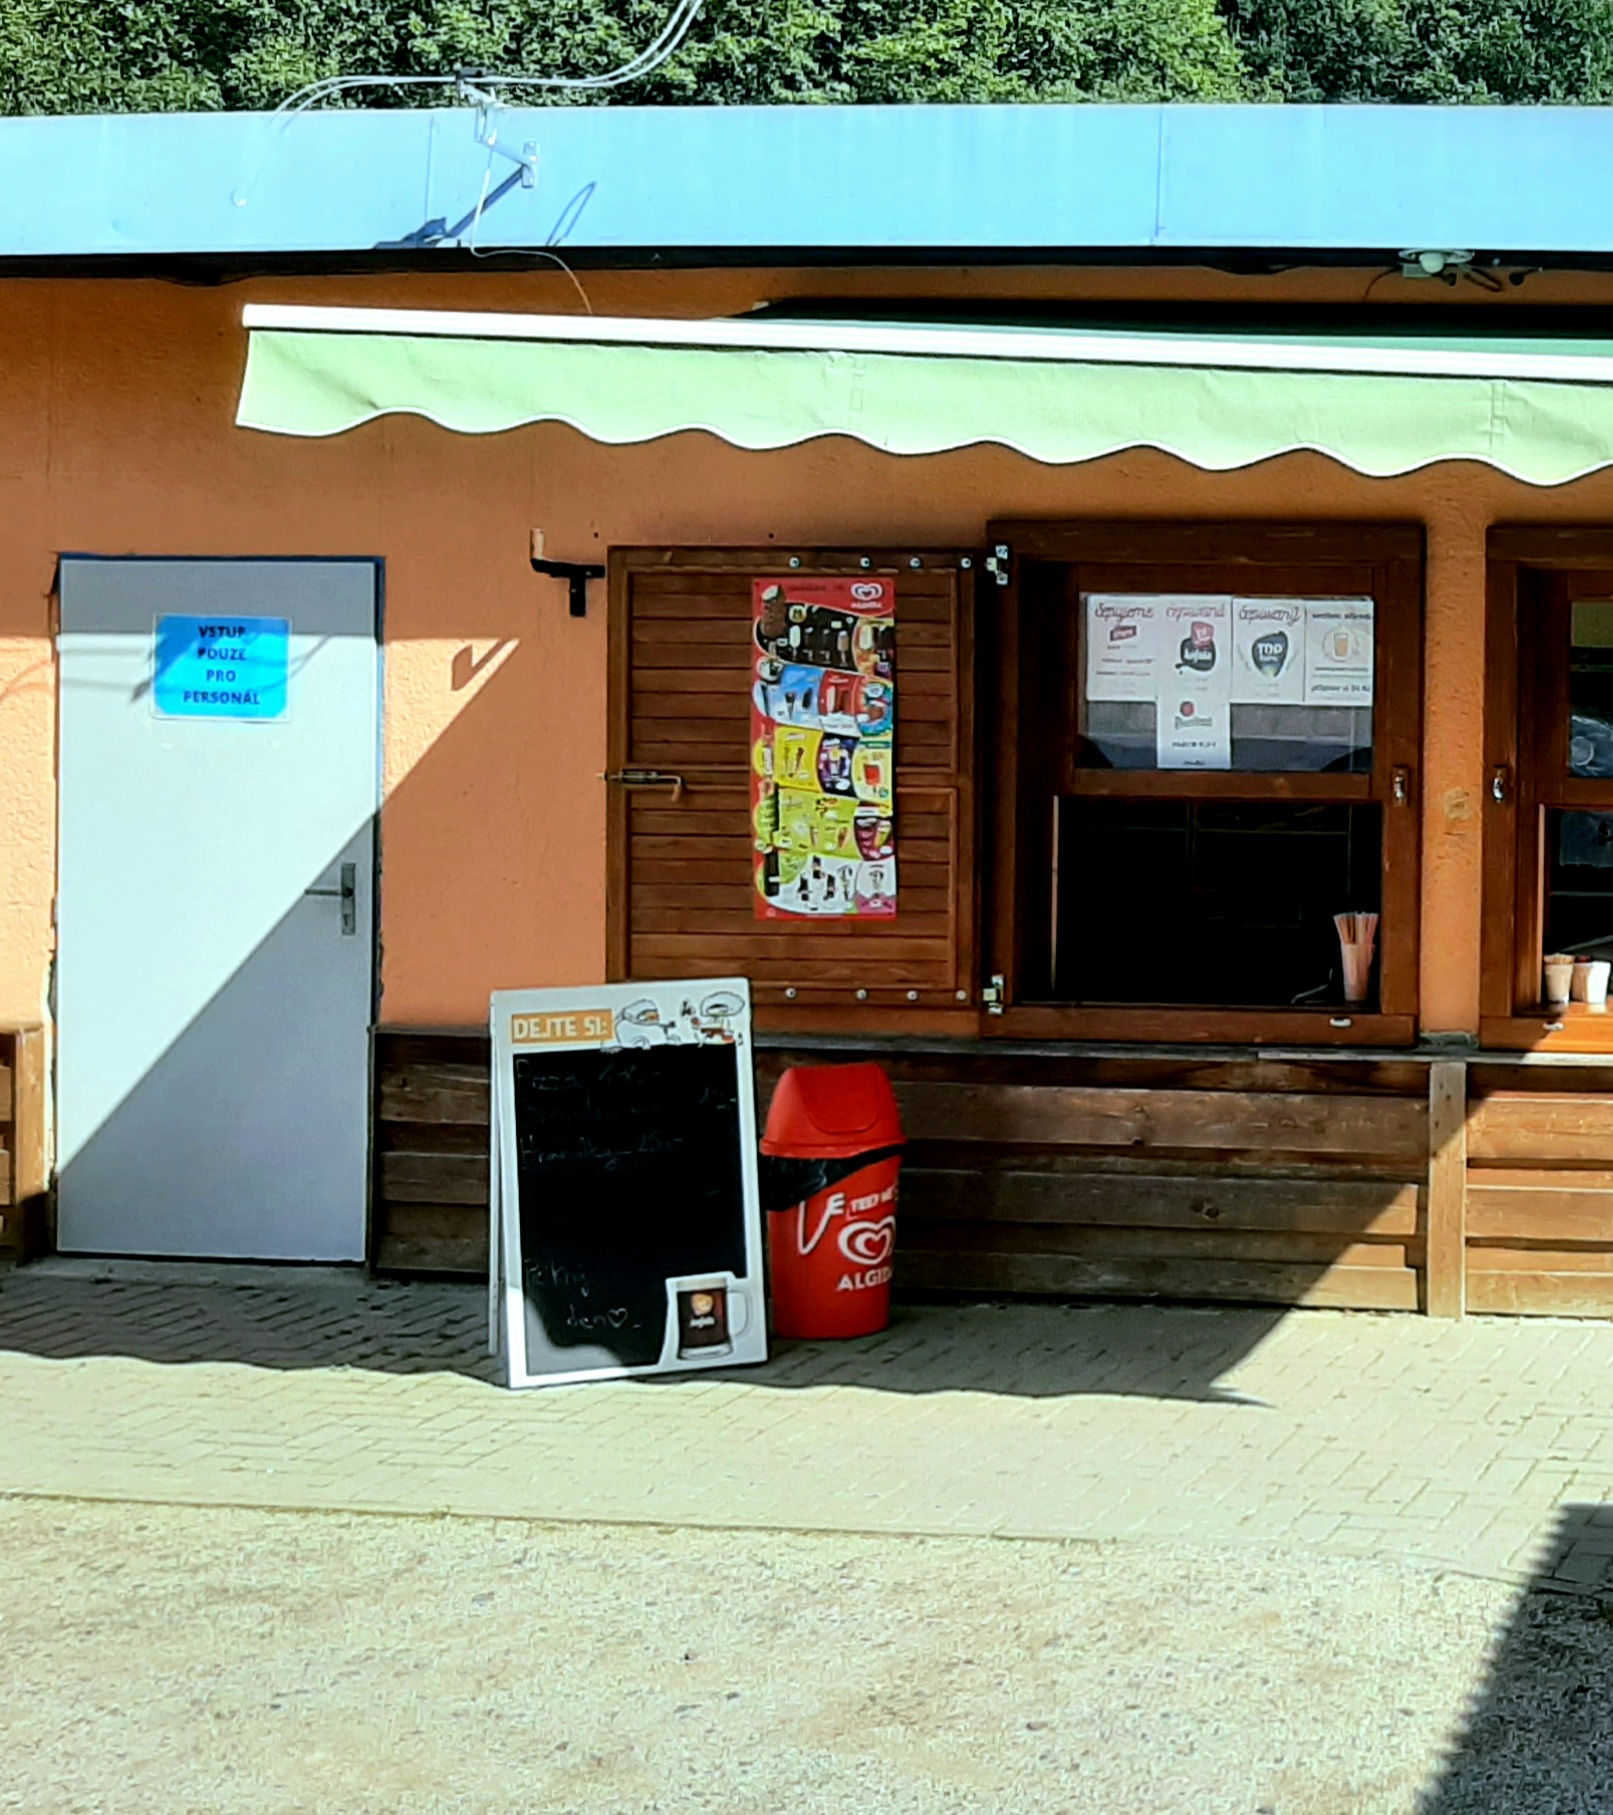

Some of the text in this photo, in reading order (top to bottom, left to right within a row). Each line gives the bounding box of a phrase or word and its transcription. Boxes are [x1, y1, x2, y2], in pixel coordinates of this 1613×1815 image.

[198, 625, 247, 639] VSTUP
[197, 648, 247, 661] POUZE
[206, 669, 237, 682] PRO
[513, 1016, 577, 1040] DEJTE
